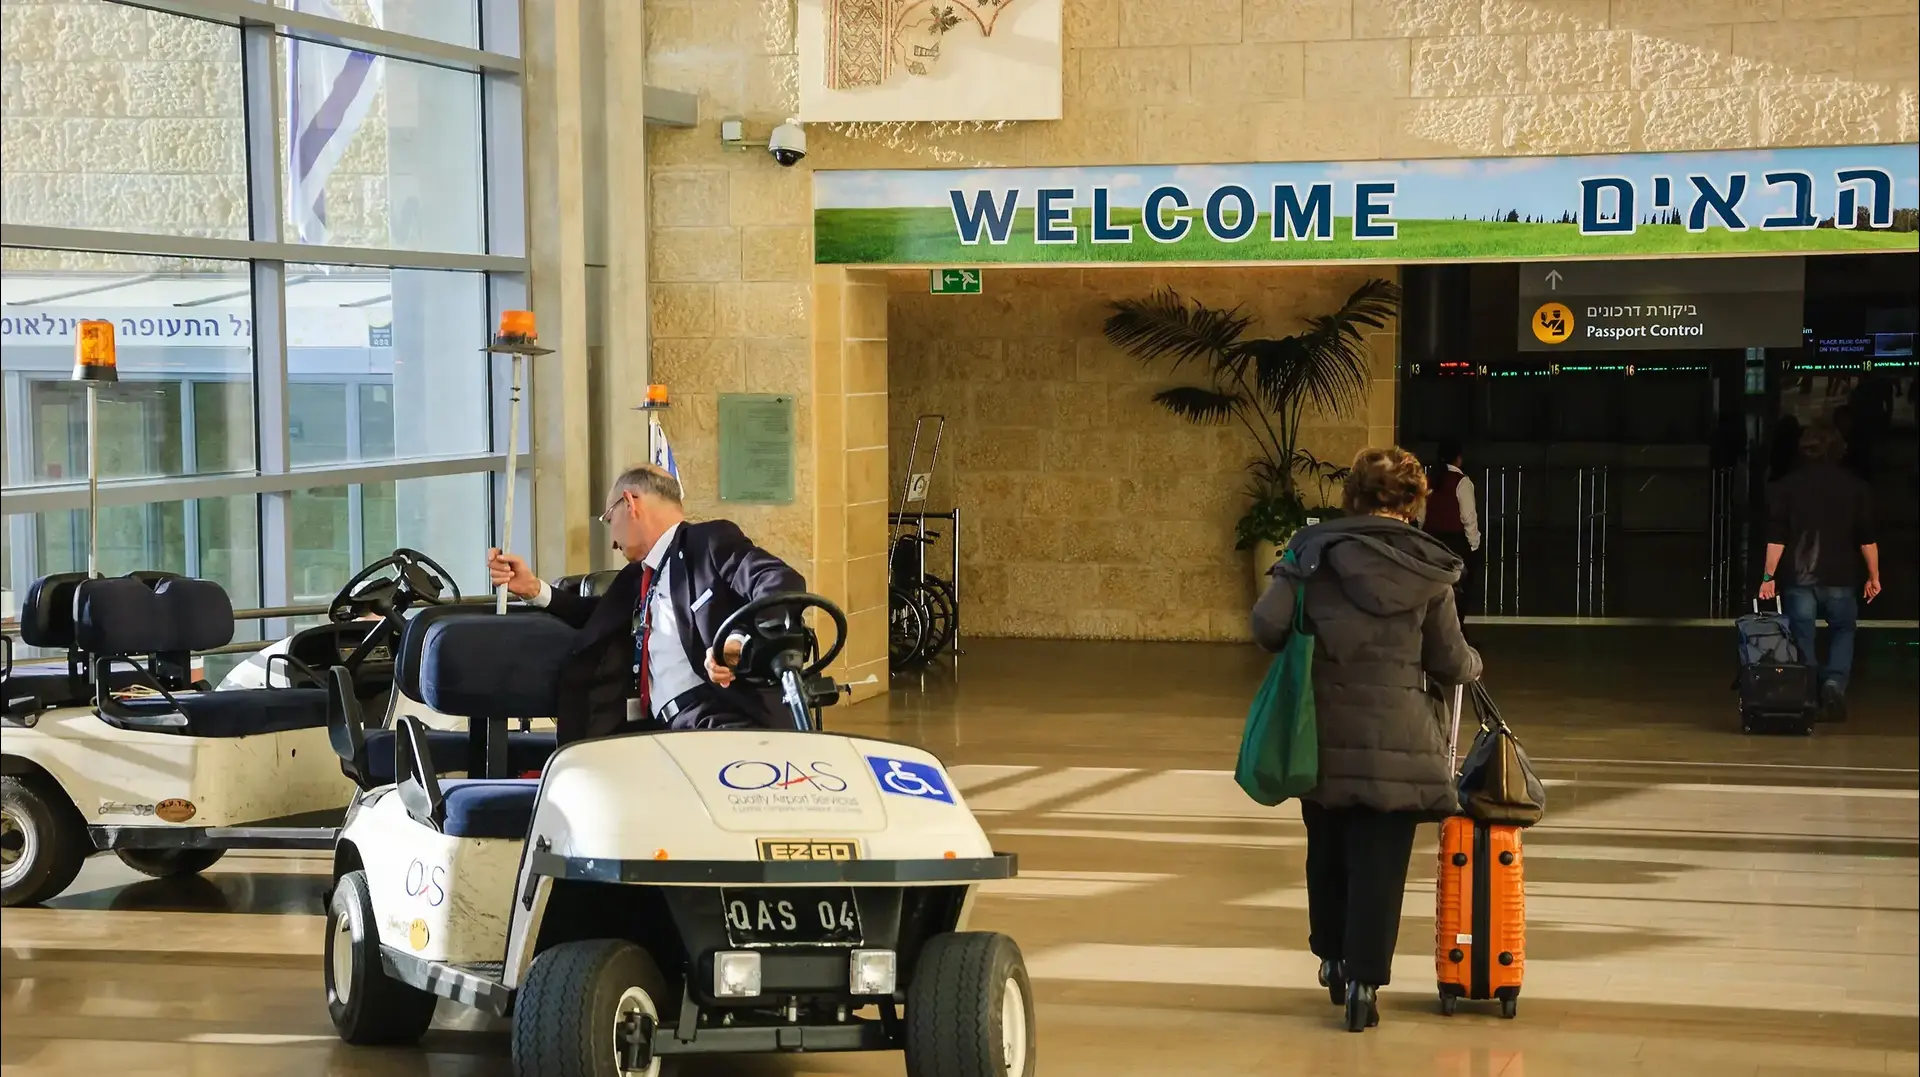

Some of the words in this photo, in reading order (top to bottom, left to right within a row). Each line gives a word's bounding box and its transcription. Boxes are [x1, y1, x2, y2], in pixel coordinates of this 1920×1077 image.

[1580, 167, 1894, 236] הבאים
[949, 181, 1398, 245] WELCOME
[1587, 305, 1641, 317] דרכונים
[1646, 304, 1698, 319] ביקורת
[121, 318, 219, 337] התעופה
[1587, 325, 1647, 340] Passport
[1650, 323, 1703, 336] Control
[1411, 364, 1421, 375] 13
[1478, 365, 1488, 376] 14
[1550, 364, 1560, 375] 15
[1625, 364, 1635, 376] 16
[1782, 360, 1791, 370] 17
[1862, 360, 1872, 371] 18
[728, 793, 768, 805] Quality
[773, 793, 808, 804] Airport
[730, 900, 797, 930] QAS
[818, 900, 854, 930] 04
